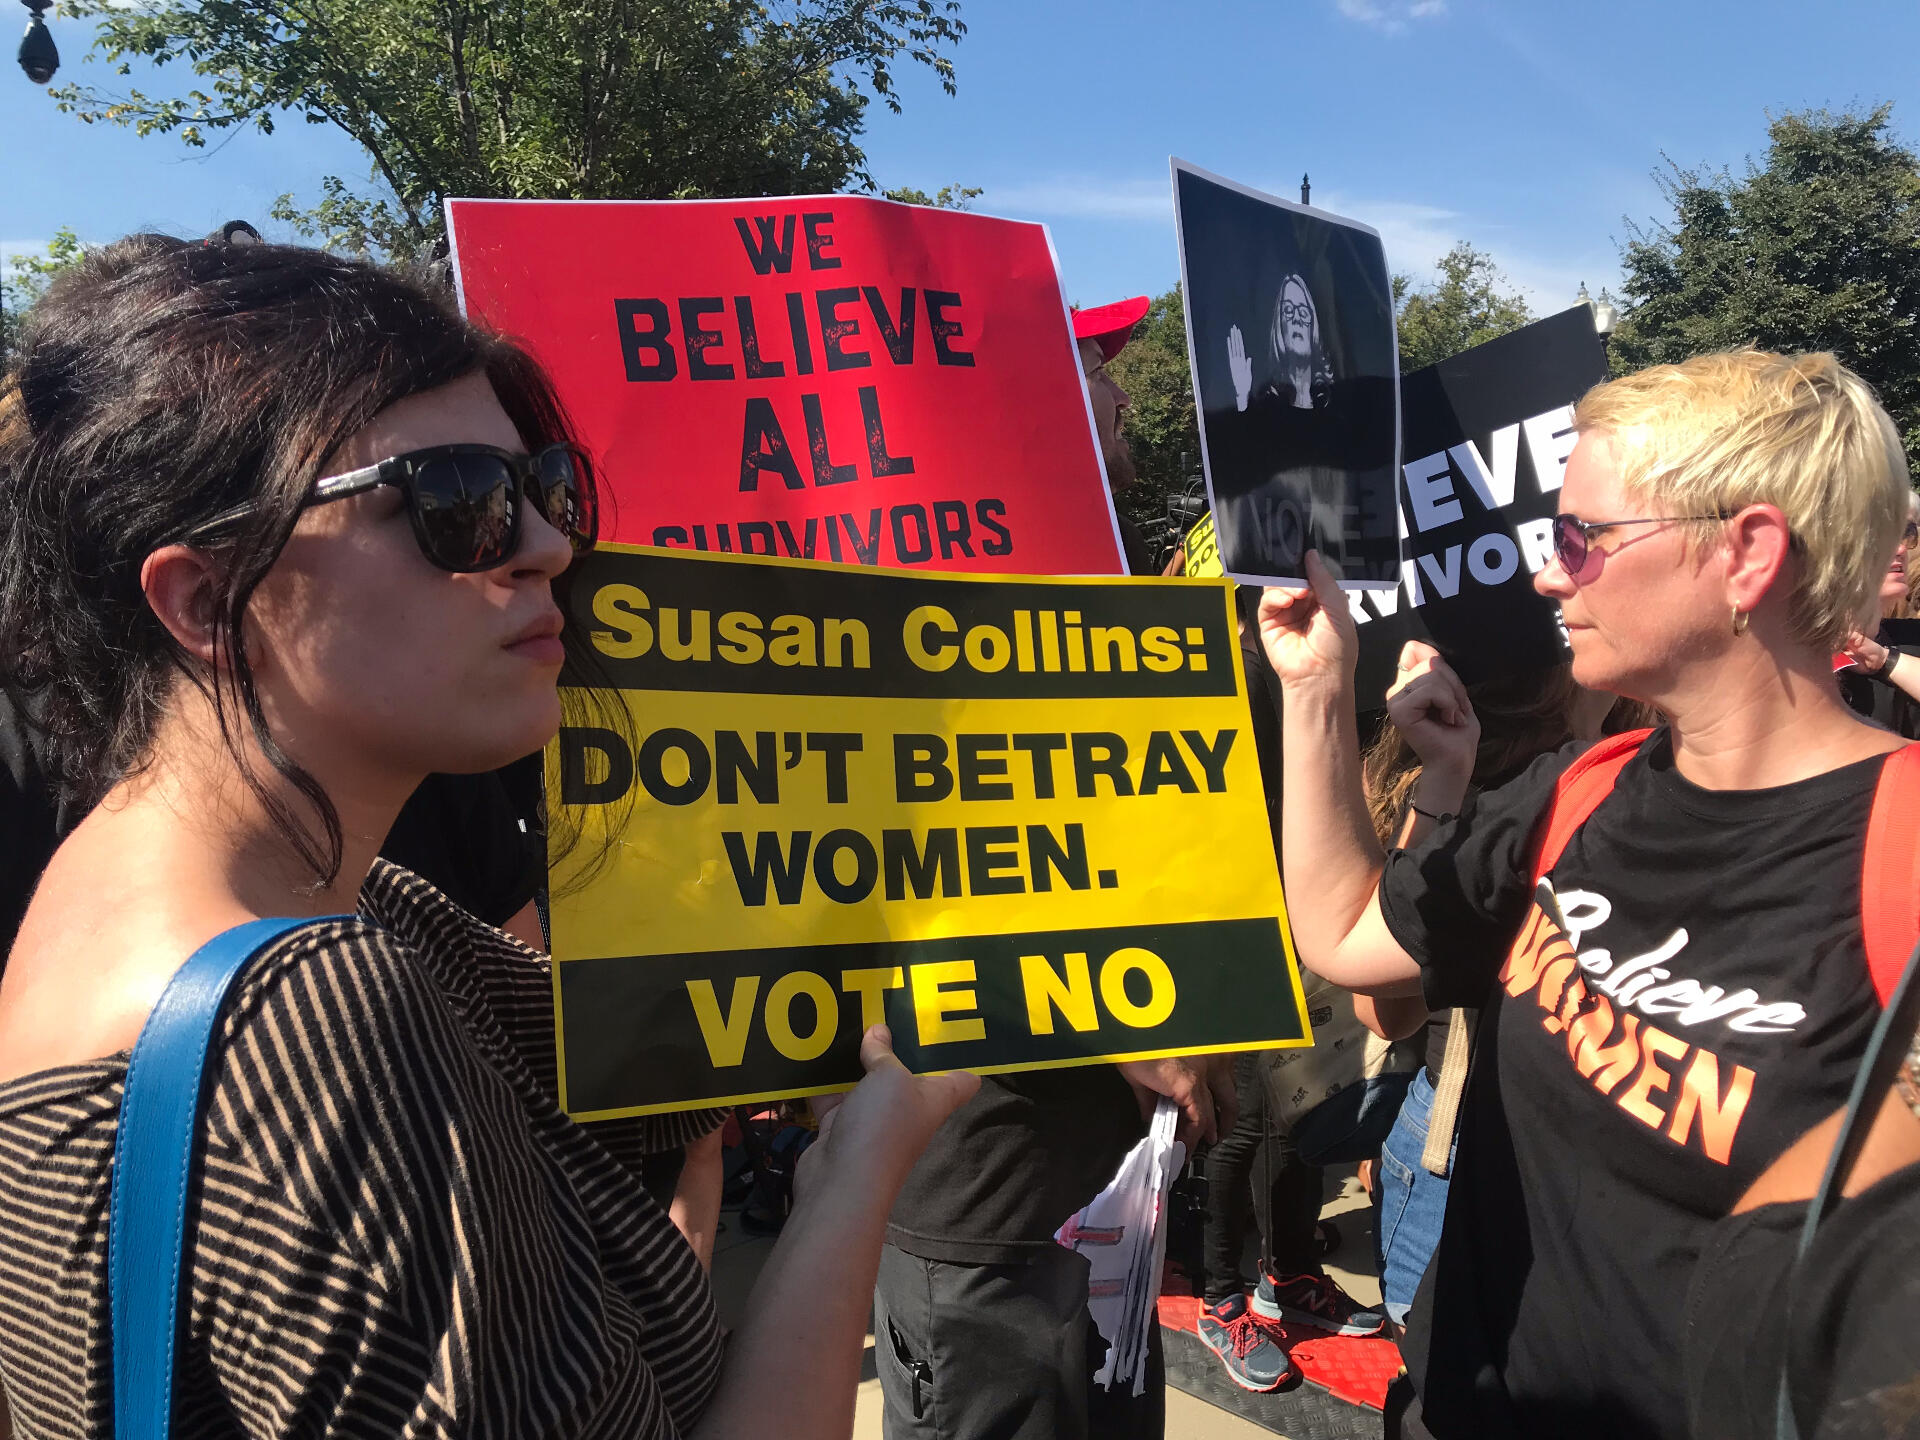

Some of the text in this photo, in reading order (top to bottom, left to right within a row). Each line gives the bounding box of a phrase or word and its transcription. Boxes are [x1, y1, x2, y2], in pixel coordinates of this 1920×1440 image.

[733, 212, 841, 275] WE
[613, 285, 976, 382] BELIEVE
[738, 385, 915, 492] ALL
[1400, 405, 1579, 539] EVE
[591, 584, 1208, 674] Susan Collins:
[559, 727, 1239, 807] DON'T BETRAY
[722, 823, 1118, 907] WOMEN.
[685, 947, 1177, 1068] VOTE NO
